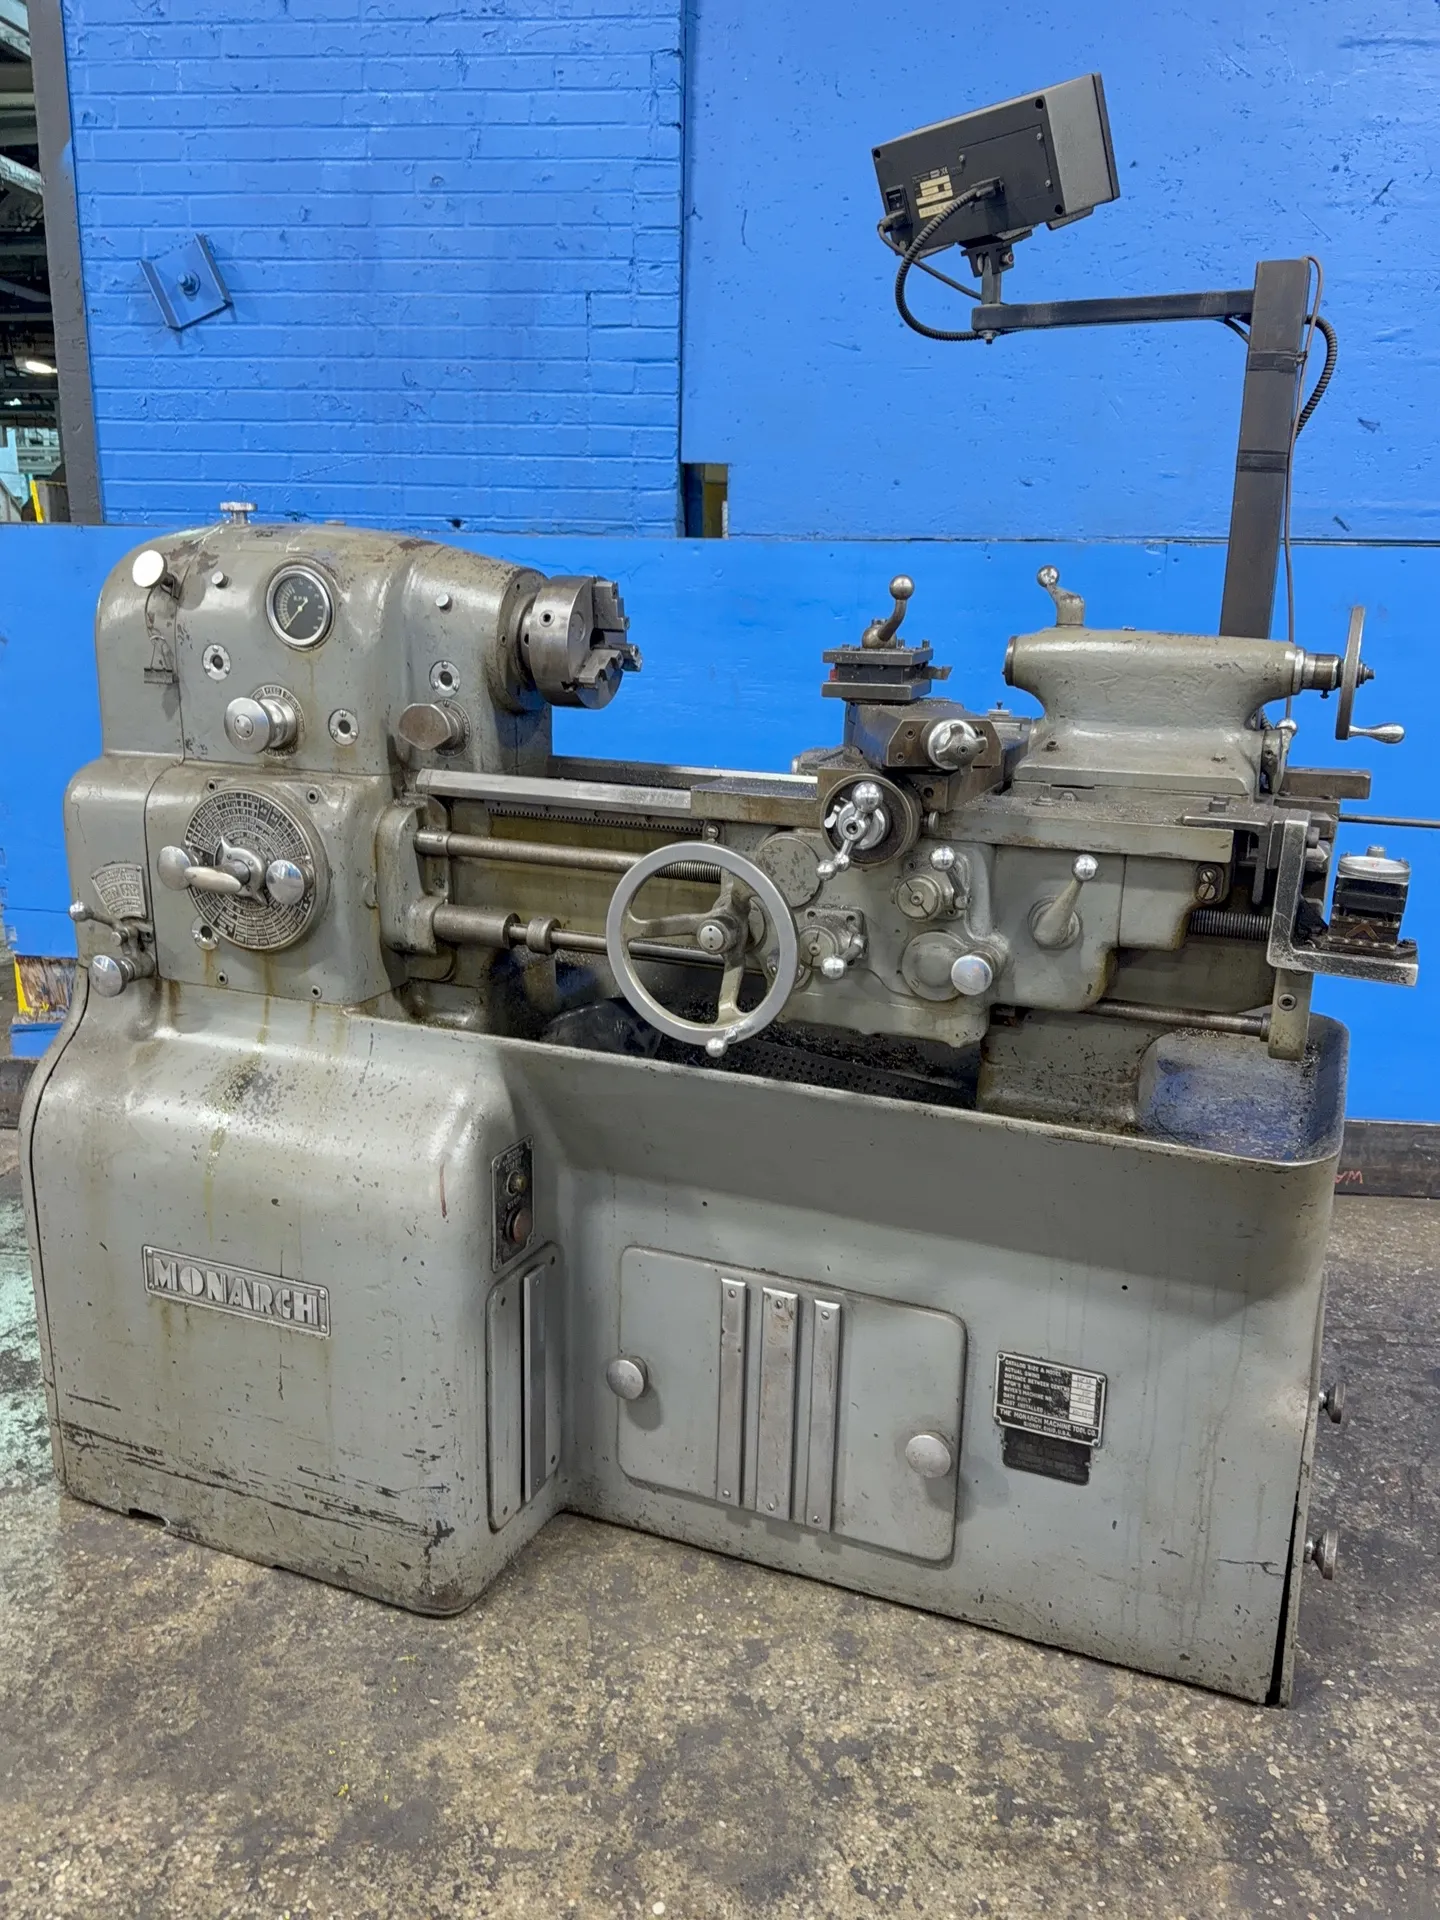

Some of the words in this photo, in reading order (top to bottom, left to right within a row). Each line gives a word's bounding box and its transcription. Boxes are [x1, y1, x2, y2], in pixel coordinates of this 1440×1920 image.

[153, 1257, 318, 1326] MONARCH
[1004, 1366, 1023, 1375] ACTUAL
[1004, 1372, 1026, 1382] DISTANCE
[1027, 1377, 1050, 1387] BETWEEN
[1003, 1392, 1015, 1400] DATE
[1022, 1389, 1044, 1399] MACHINE
[1017, 1402, 1043, 1413] INSTALLED
[999, 1408, 1012, 1417] THE
[1013, 1411, 1043, 1424] MONARCH
[1043, 1419, 1071, 1431] MACHINE
[1072, 1425, 1086, 1435] TOOL
